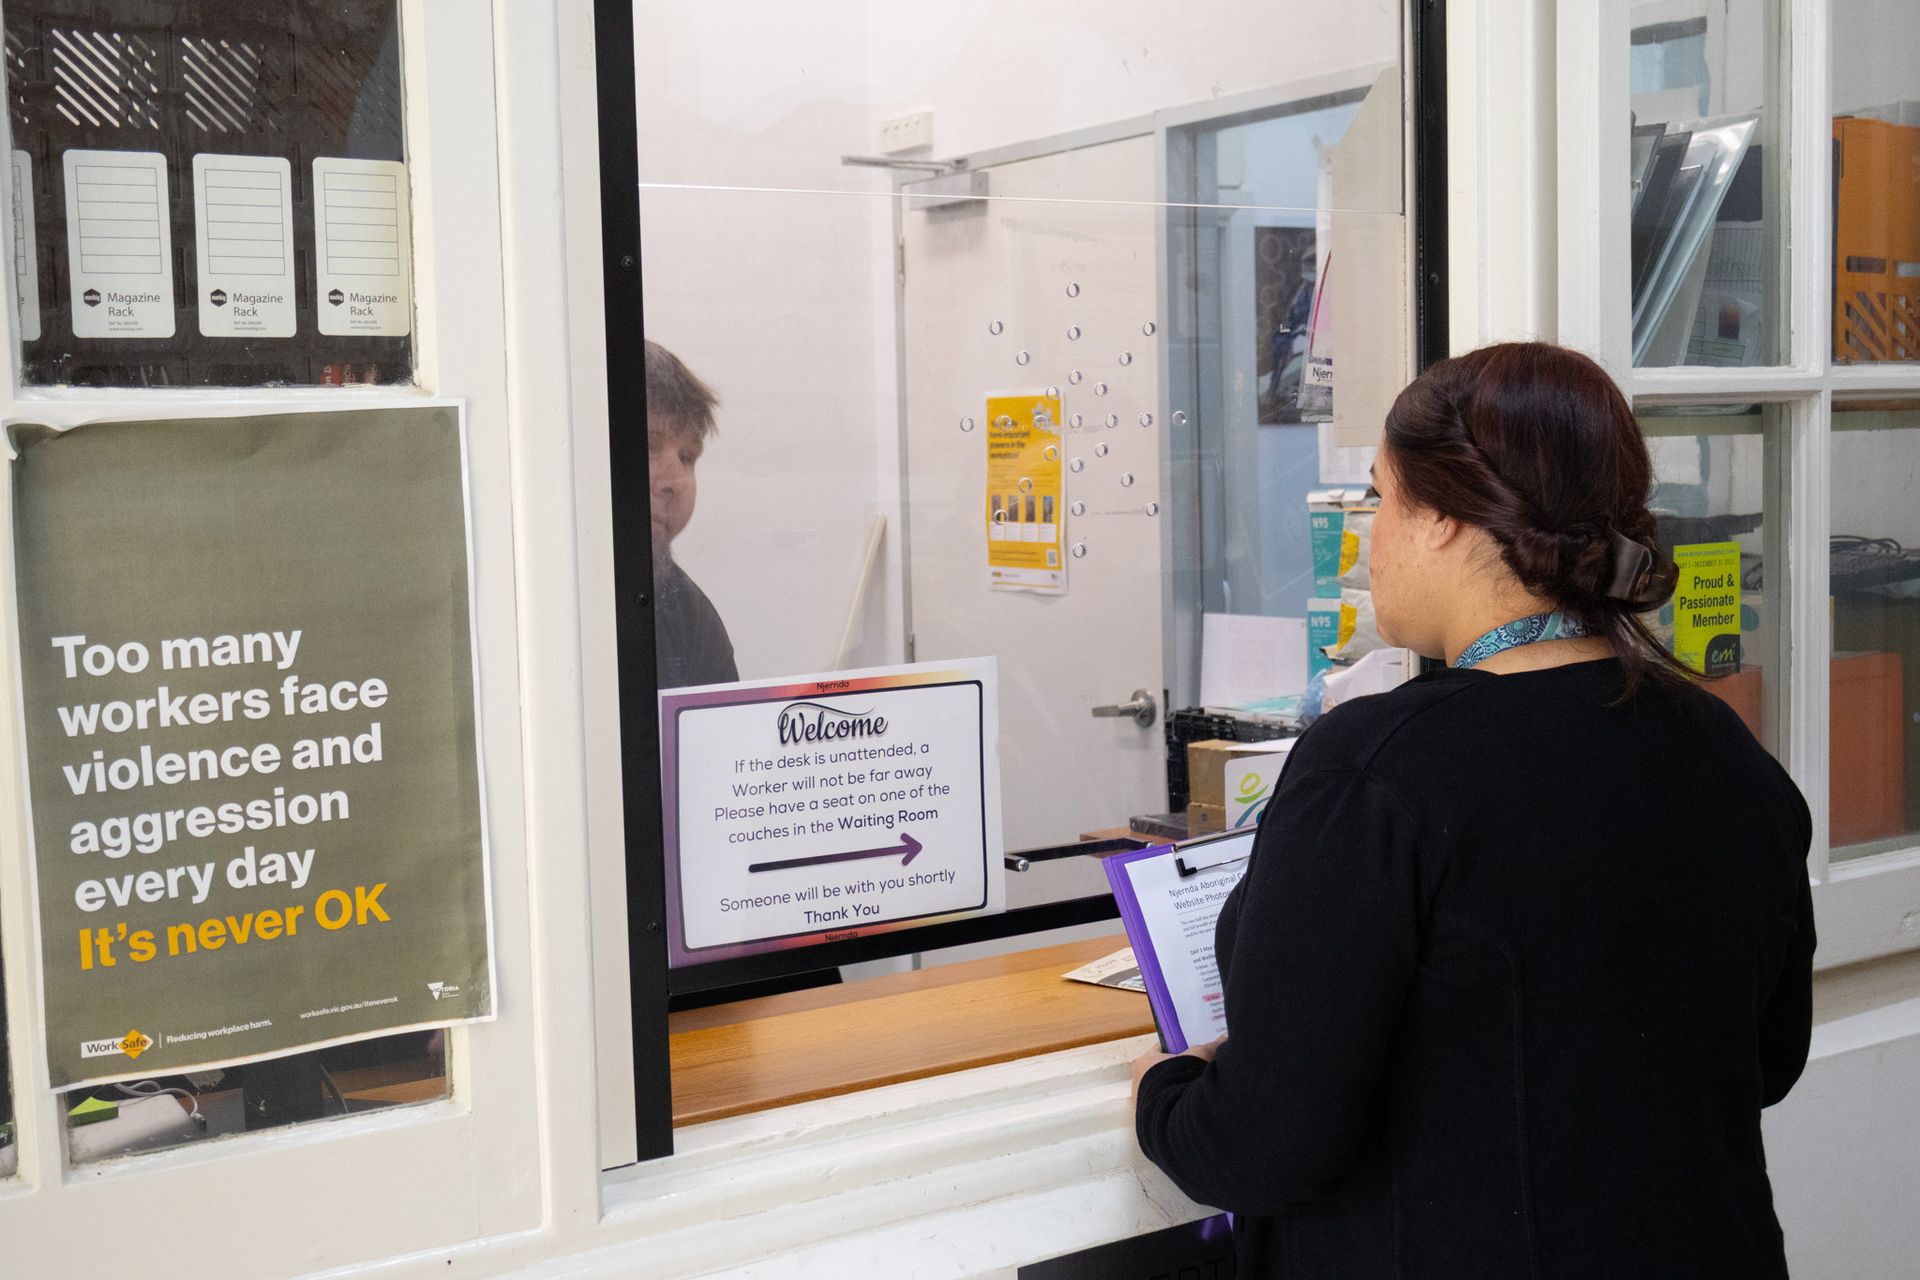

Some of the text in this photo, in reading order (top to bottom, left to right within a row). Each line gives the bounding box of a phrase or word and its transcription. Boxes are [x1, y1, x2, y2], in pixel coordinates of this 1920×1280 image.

[108, 293, 160, 305] Magazine
[233, 293, 283, 305] Magazine
[350, 293, 398, 304] Magazine
[109, 307, 134, 316] Rack
[234, 307, 258, 316] Rack
[351, 306, 373, 316] Rack
[1312, 517, 1328, 528] N95
[1694, 574, 1735, 590] Proud &
[1680, 595, 1734, 611] Passionate
[1310, 616, 1331, 626] N95
[1692, 612, 1734, 628] Member
[52, 630, 302, 679] Too many
[816, 680, 849, 692] Njernda
[58, 676, 388, 738] workers face
[778, 702, 888, 745] Welcome
[63, 723, 384, 795] violence and
[734, 744, 930, 774] If the desk is unattended, a
[732, 766, 932, 798] Worker will not be far away
[715, 782, 950, 822] Please have a seat on one of the
[70, 788, 350, 859] aggression
[728, 808, 938, 844] couches in the Waiting Room
[75, 846, 315, 912] every day
[1168, 884, 1199, 899] Njernda
[1200, 874, 1237, 890] Aboriginal
[720, 870, 956, 912] Someone will be with you shortly
[804, 903, 880, 924] Thank You
[1173, 896, 1204, 910] Website
[168, 905, 304, 956] never
[315, 883, 391, 930] OK
[825, 930, 858, 942] Njernda
[300, 996, 399, 1020] worksafe.vic.gov.au/itsneverok
[166, 1030, 207, 1044] Reducing
[208, 1024, 250, 1038] workplace
[250, 1019, 272, 1030] harm.
